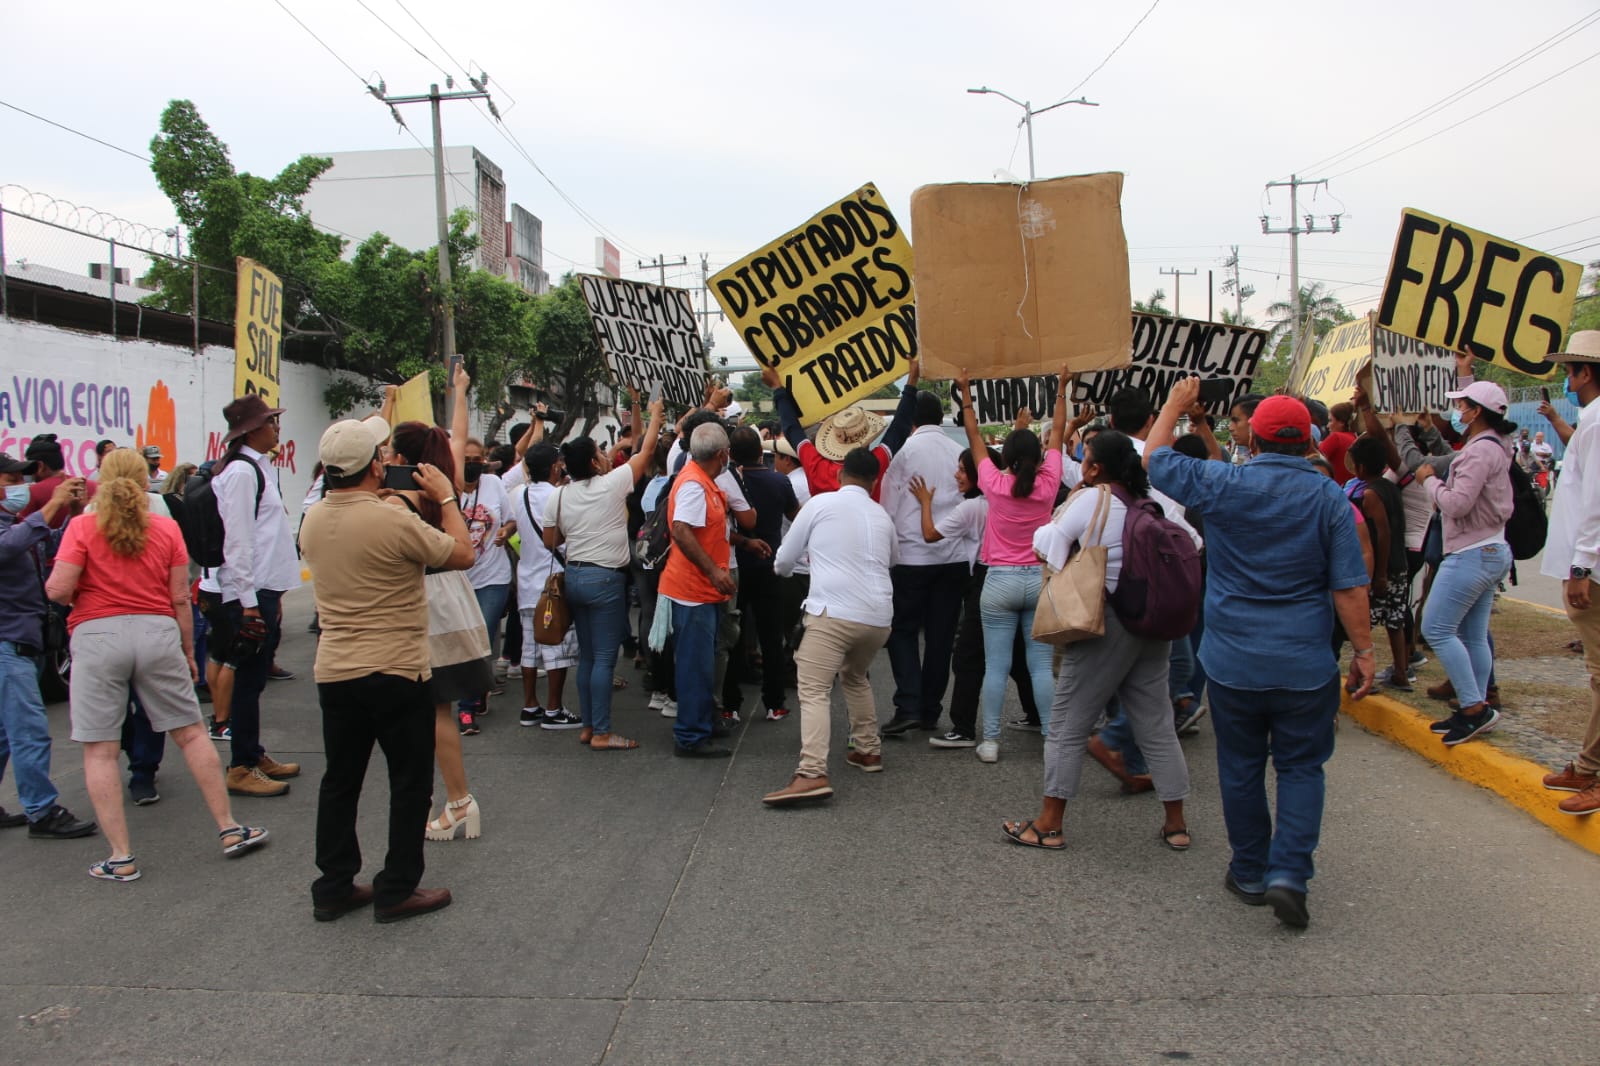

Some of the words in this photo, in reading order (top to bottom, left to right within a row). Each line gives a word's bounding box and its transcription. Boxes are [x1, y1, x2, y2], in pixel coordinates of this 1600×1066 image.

[717, 198, 897, 319] DIPUTADOS
[250, 268, 282, 333] FUE
[582, 276, 697, 333] QUEREMOS
[744, 247, 911, 368] COBARDES
[1376, 213, 1564, 376] FREG
[592, 315, 710, 373] AUDIENCIA
[1132, 316, 1266, 376] DIENCIA
[13, 375, 134, 436] VIOLENCIA
[1374, 363, 1421, 412] SENADOR
